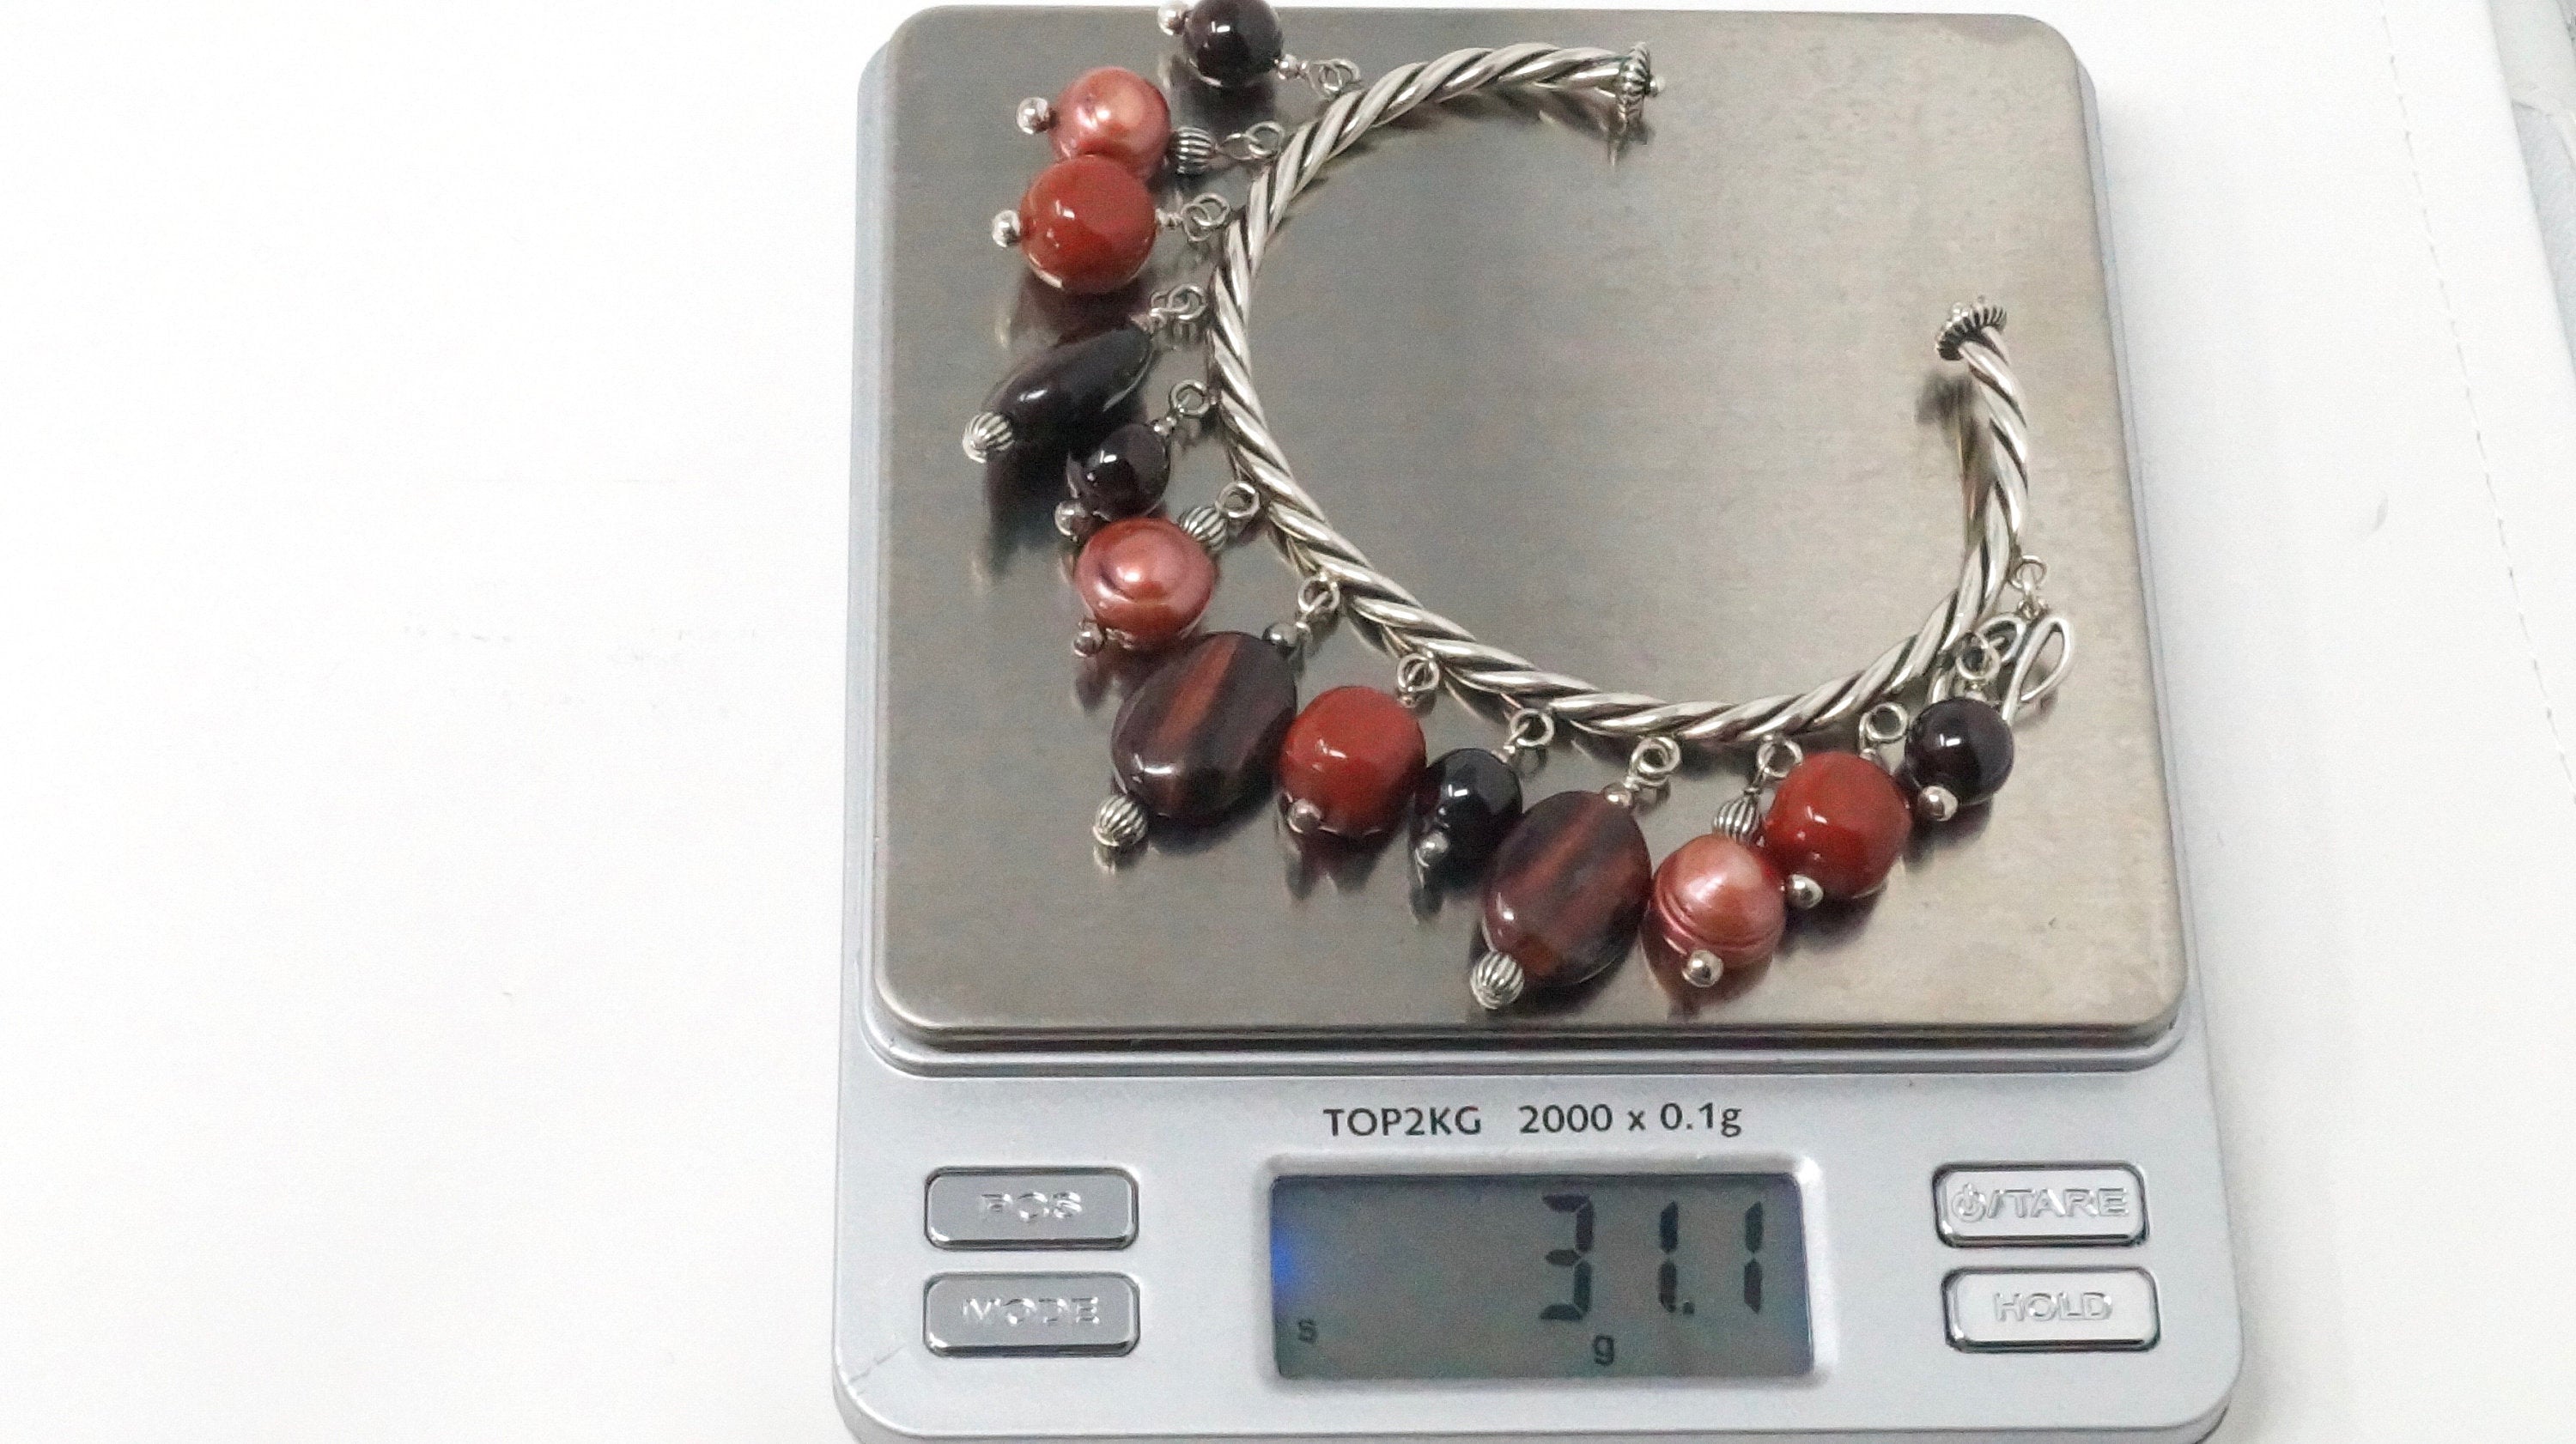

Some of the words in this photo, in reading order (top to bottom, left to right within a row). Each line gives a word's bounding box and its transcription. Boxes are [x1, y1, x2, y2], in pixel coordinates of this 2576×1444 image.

[1323, 1106, 1482, 1136] TOP2KG
[1518, 1103, 1613, 1134] 2000
[1627, 1110, 1645, 1132] x
[1659, 1102, 1743, 1137] 0.1g
[1540, 1194, 1765, 1321] 31.1
[962, 1297, 1100, 1325] MODE
[1994, 1292, 2112, 1321] HOLD
[1593, 1334, 1616, 1366] g
